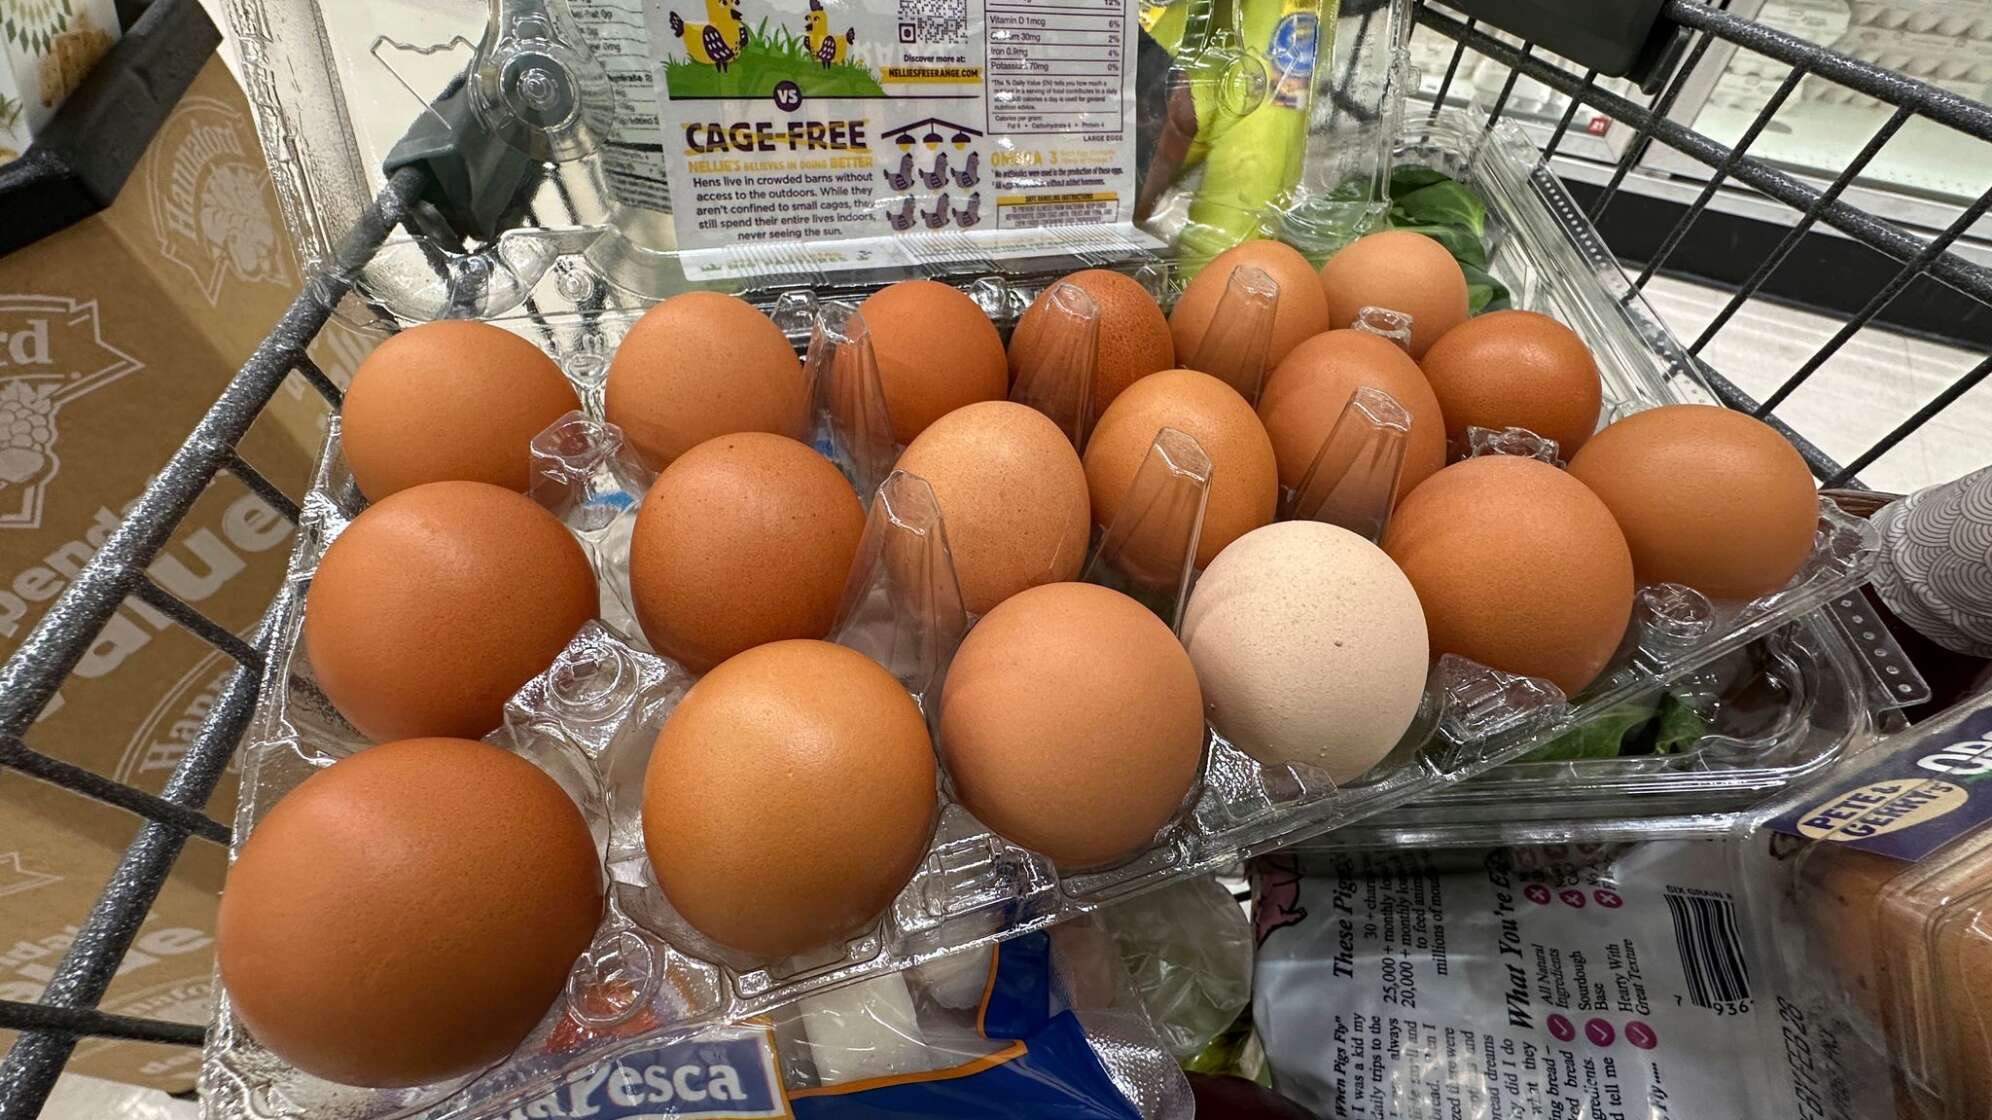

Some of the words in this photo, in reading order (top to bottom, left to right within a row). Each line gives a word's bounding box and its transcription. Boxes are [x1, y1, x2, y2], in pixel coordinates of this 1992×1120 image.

[990, 15, 1017, 25] Vitamin
[1018, 16, 1025, 24] D
[904, 54, 934, 63] Discover
[990, 47, 1005, 55] Iron
[888, 68, 978, 78] NELLIESFREERANGE.COM
[777, 89, 798, 104] VS
[686, 121, 867, 153] CAGE-FREE
[693, 177, 721, 188] Hens
[723, 175, 742, 186] live
[744, 175, 754, 185] in
[756, 174, 802, 186] crowded
[805, 173, 833, 183] barns
[835, 172, 873, 182] without
[696, 192, 733, 202] access
[735, 191, 747, 200] to
[749, 189, 766, 199] the
[768, 187, 818, 198] outdoors.
[820, 185, 849, 196] While
[851, 185, 873, 196] they
[696, 204, 728, 216] aren't
[730, 203, 775, 214] confined
[778, 202, 790, 212] to
[792, 200, 818, 211] small
[820, 201, 852, 212] cages,
[853, 199, 875, 209] they
[698, 218, 718, 230] still
[720, 217, 752, 230] spend
[754, 216, 778, 226] their
[781, 216, 810, 225] entire
[811, 214, 835, 223] lives
[837, 212, 877, 222] indoors,
[737, 231, 767, 241] never
[769, 228, 802, 239] seeing
[803, 228, 822, 237] the
[823, 228, 843, 236] sun.
[1802, 792, 1888, 830] PETE
[1841, 782, 1954, 837] GERRY'S
[1380, 895, 1397, 943] monthly
[1396, 898, 1413, 946] monthly
[1412, 907, 1427, 934] feed
[1429, 906, 1443, 922] of
[1494, 892, 1523, 959] You're
[1364, 923, 1378, 940] 30
[1416, 936, 1428, 949] to
[1333, 919, 1353, 979] These
[1432, 925, 1448, 976] millions
[1605, 943, 1623, 970] With
[1624, 938, 1642, 981] Texture
[1531, 943, 1550, 984] Natural
[1382, 957, 1400, 1004] 25,000
[1400, 961, 1416, 1009] 20,000
[1550, 948, 1571, 1010] Ingredients
[1569, 950, 1592, 1011] Sourdough
[1505, 963, 1534, 1030] What
[1538, 985, 1554, 1006] All
[1594, 982, 1609, 1011] Base
[1615, 973, 1634, 1013] Hearty
[1634, 983, 1651, 1016] Great
[1353, 1013, 1366, 1033] my
[1368, 1015, 1381, 1034] the
[1404, 1019, 1417, 1044] and
[1422, 1022, 1436, 1030] I
[1351, 1037, 1364, 1058] kid
[1371, 1038, 1382, 1050] to
[1387, 1017, 1402, 1060] always
[1444, 1027, 1456, 1058] were
[1460, 1029, 1475, 1055] and
[1500, 1038, 1514, 1055] do
[1334, 1047, 1349, 1076] Pigs
[1355, 1063, 1364, 1071] a
[1369, 1054, 1386, 1082] trips
[1483, 1033, 1498, 1081] dreams
[1522, 1041, 1538, 1070] they
[1559, 1050, 1578, 1088] bread
[1603, 1056, 1617, 1079] me
[1355, 1075, 1364, 1100] was
[1503, 1072, 1520, 1095] did
[1542, 1057, 1560, 1097] bread
[1335, 1078, 1348, 1118] When
[1604, 1084, 1622, 1106] tell
